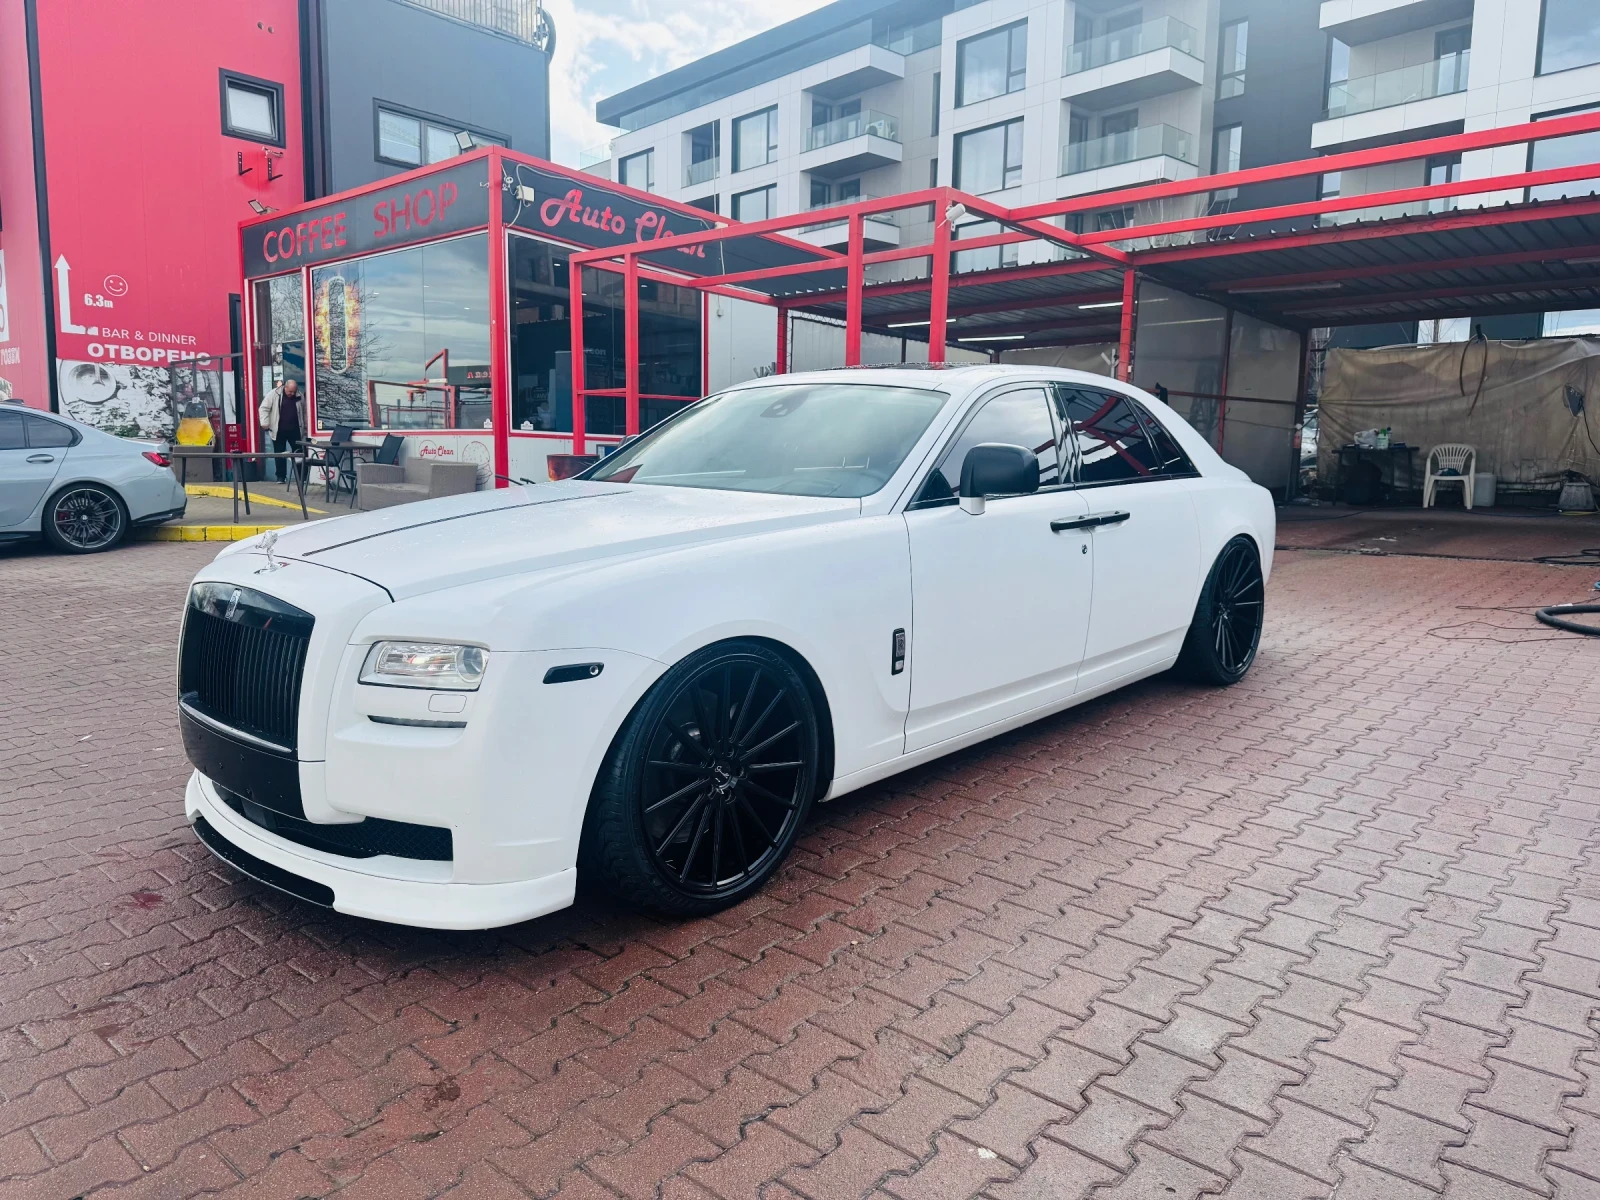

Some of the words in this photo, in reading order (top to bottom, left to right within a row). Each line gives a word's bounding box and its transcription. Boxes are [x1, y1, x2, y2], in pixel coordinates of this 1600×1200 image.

[540, 189, 626, 235] Auto
[263, 212, 347, 263] COFFEE
[373, 182, 458, 238] SHOP
[84, 293, 114, 308] 6.3m
[102, 327, 130, 340] BAR
[134, 330, 144, 341] &
[148, 332, 197, 345] DINNER
[420, 445, 437, 457] Auto
